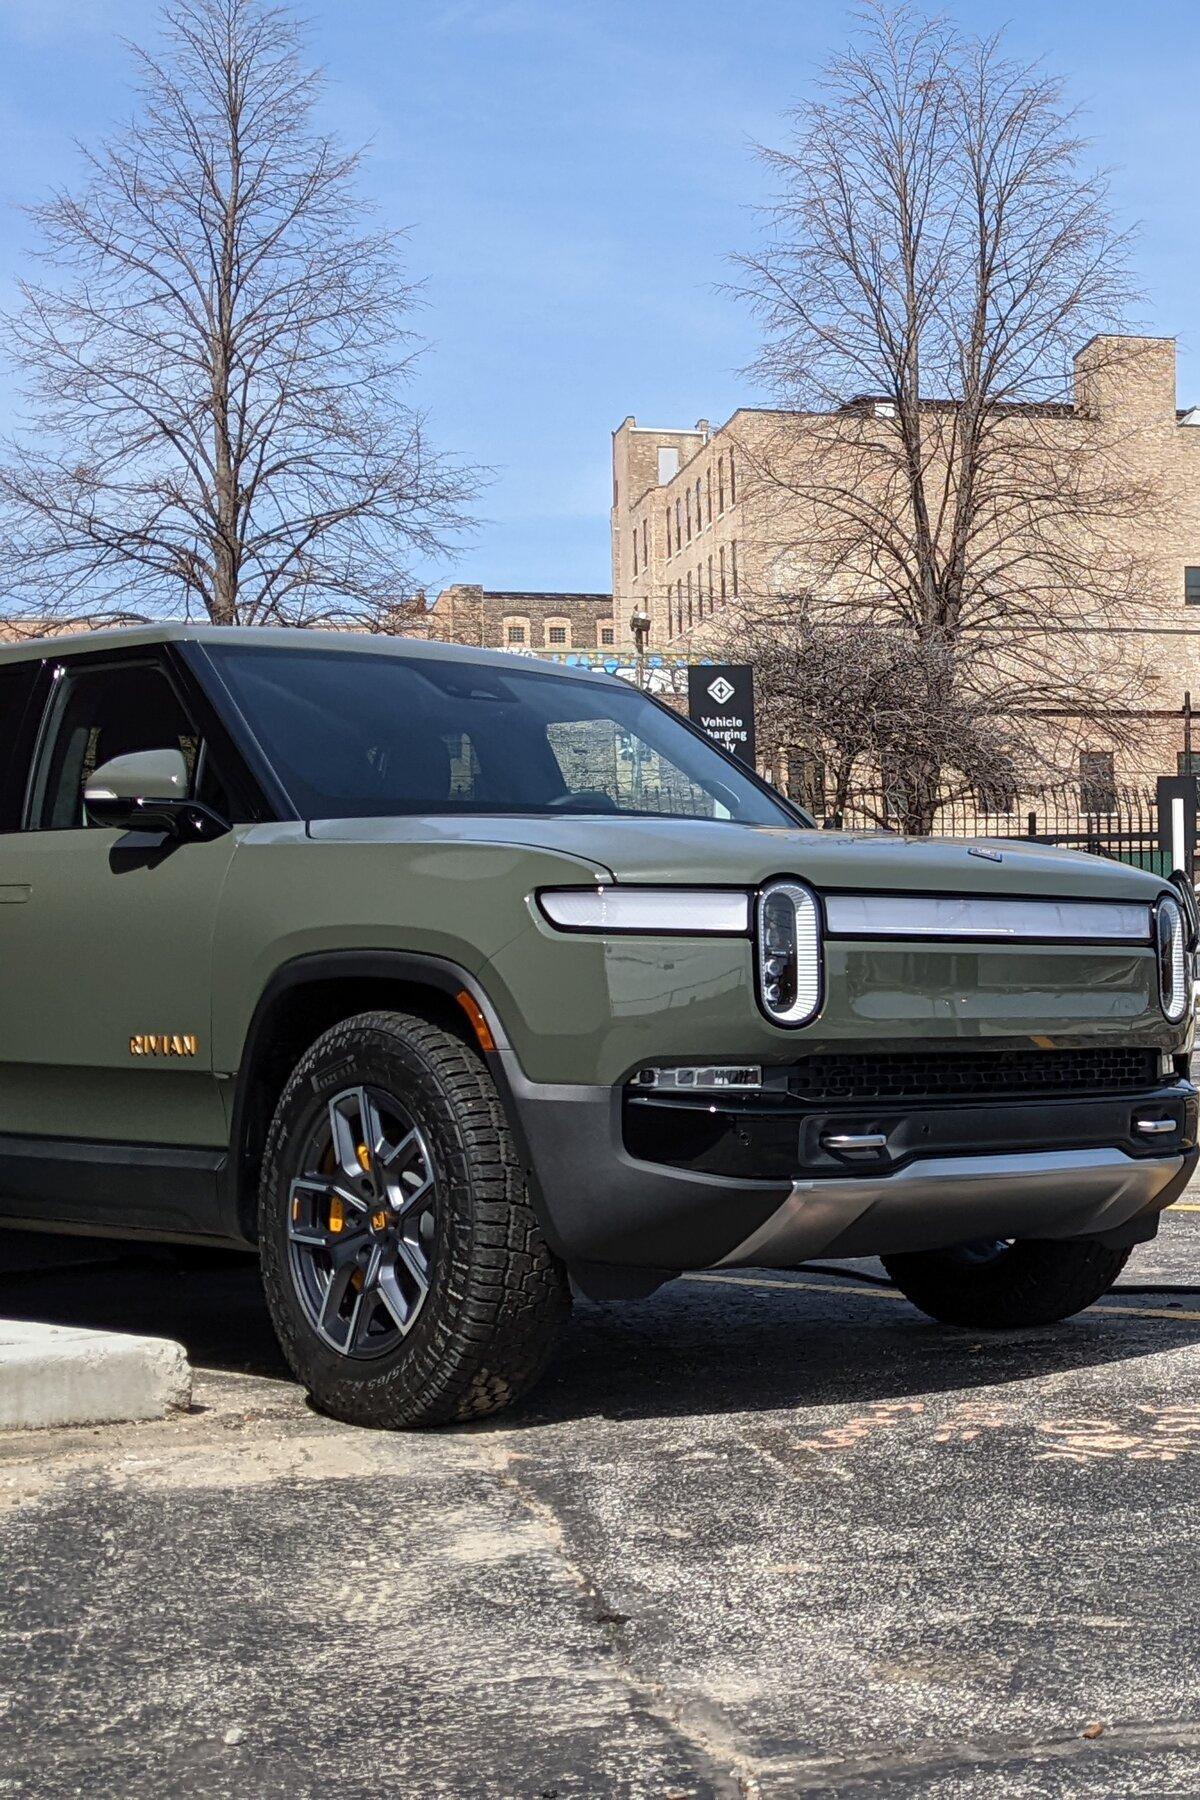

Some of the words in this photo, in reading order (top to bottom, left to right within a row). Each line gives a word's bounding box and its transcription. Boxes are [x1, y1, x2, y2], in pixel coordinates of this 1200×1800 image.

[700, 716, 743, 727] Vehicle
[704, 729, 747, 741] harging
[129, 1035, 197, 1056] RIVIAN
